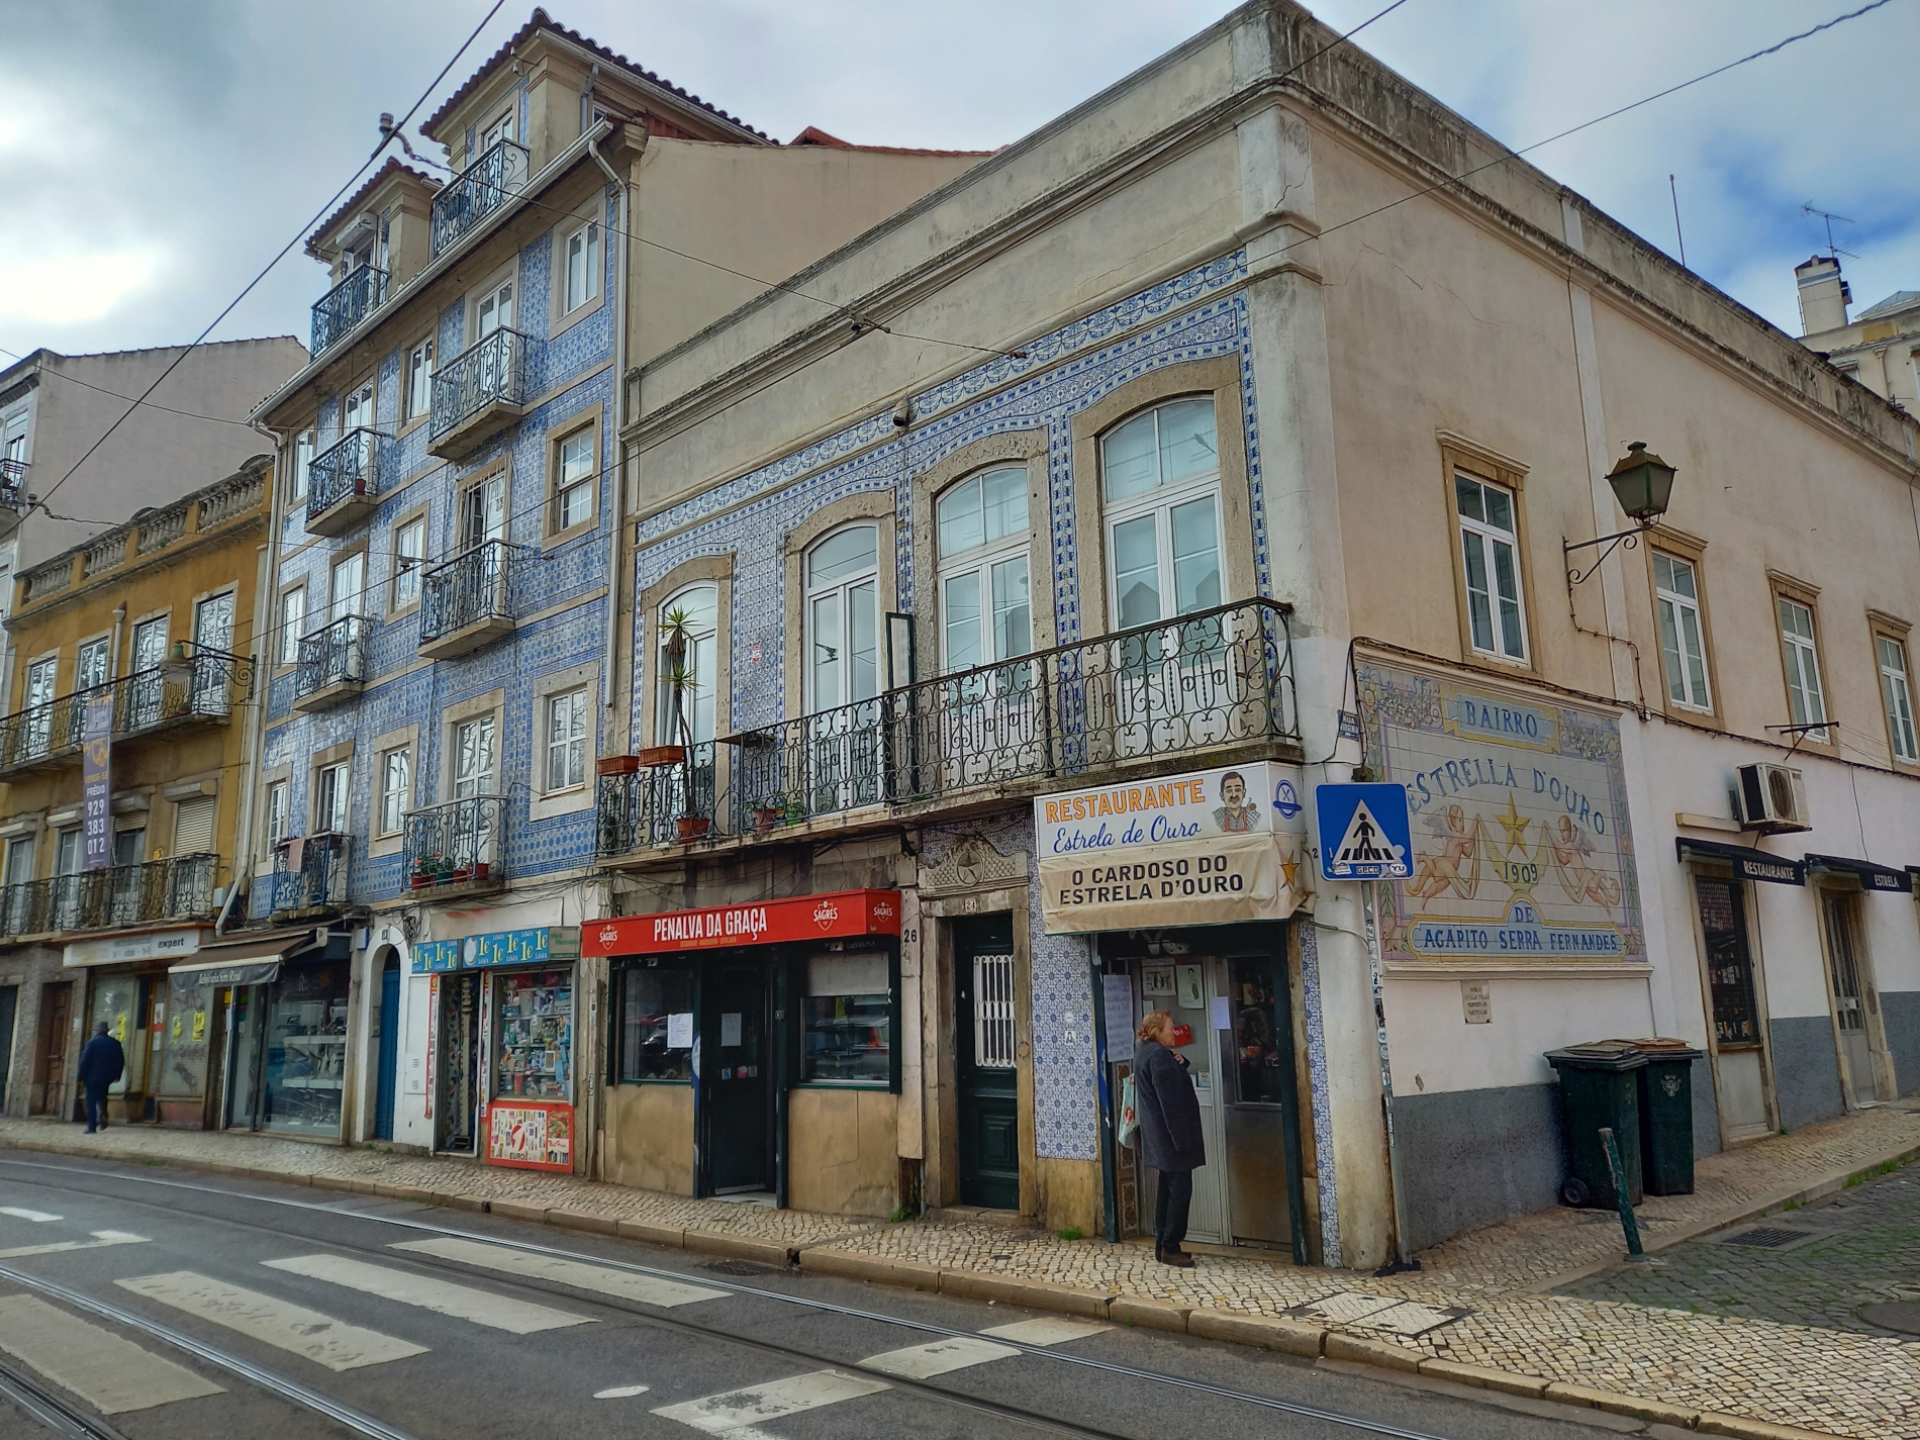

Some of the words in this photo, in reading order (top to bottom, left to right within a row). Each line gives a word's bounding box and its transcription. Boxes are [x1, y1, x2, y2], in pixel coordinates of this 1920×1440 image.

[1465, 700, 1538, 738] BAIRRO
[87, 784, 105, 797] PRÉDIO
[1407, 758, 1519, 816] ESTRELLA
[1532, 767, 1605, 835] D'OURO
[87, 799, 105, 817] 929
[1045, 779, 1206, 824] RESTAURANTE
[87, 818, 105, 836] 383
[1053, 822, 1116, 853] Estrela
[1121, 818, 1144, 844] de
[1151, 814, 1202, 842] Ouro
[87, 837, 105, 855] 012
[1072, 870, 1083, 886] O
[1092, 859, 1189, 884] CARDOSO
[1198, 855, 1227, 874] DO
[1504, 862, 1538, 884] 1909
[1743, 860, 1795, 880] RESTAURANTE
[1060, 883, 1153, 905] ESTRELA
[1161, 874, 1244, 897] D'OURO
[1874, 875, 1900, 888] ESTRELA
[813, 907, 838, 922] SAGRES
[873, 906, 893, 917] SAGRES
[1514, 906, 1534, 923] DE
[654, 914, 701, 942] PENALVA
[706, 913, 723, 938] DA
[725, 907, 768, 941] GRAÇA
[157, 937, 185, 951] expert
[479, 935, 489, 956] 1€
[507, 933, 519, 954] 1€
[536, 929, 548, 951] 1€
[599, 930, 618, 943] SAGRES
[904, 929, 917, 943] 26
[1424, 929, 1488, 949] AGAPITO
[1500, 930, 1543, 950] SERRA
[1550, 932, 1617, 951] FERNANDES
[492, 943, 503, 964] 1€
[521, 940, 533, 961] 1€
[510, 1152, 525, 1160] EURO
